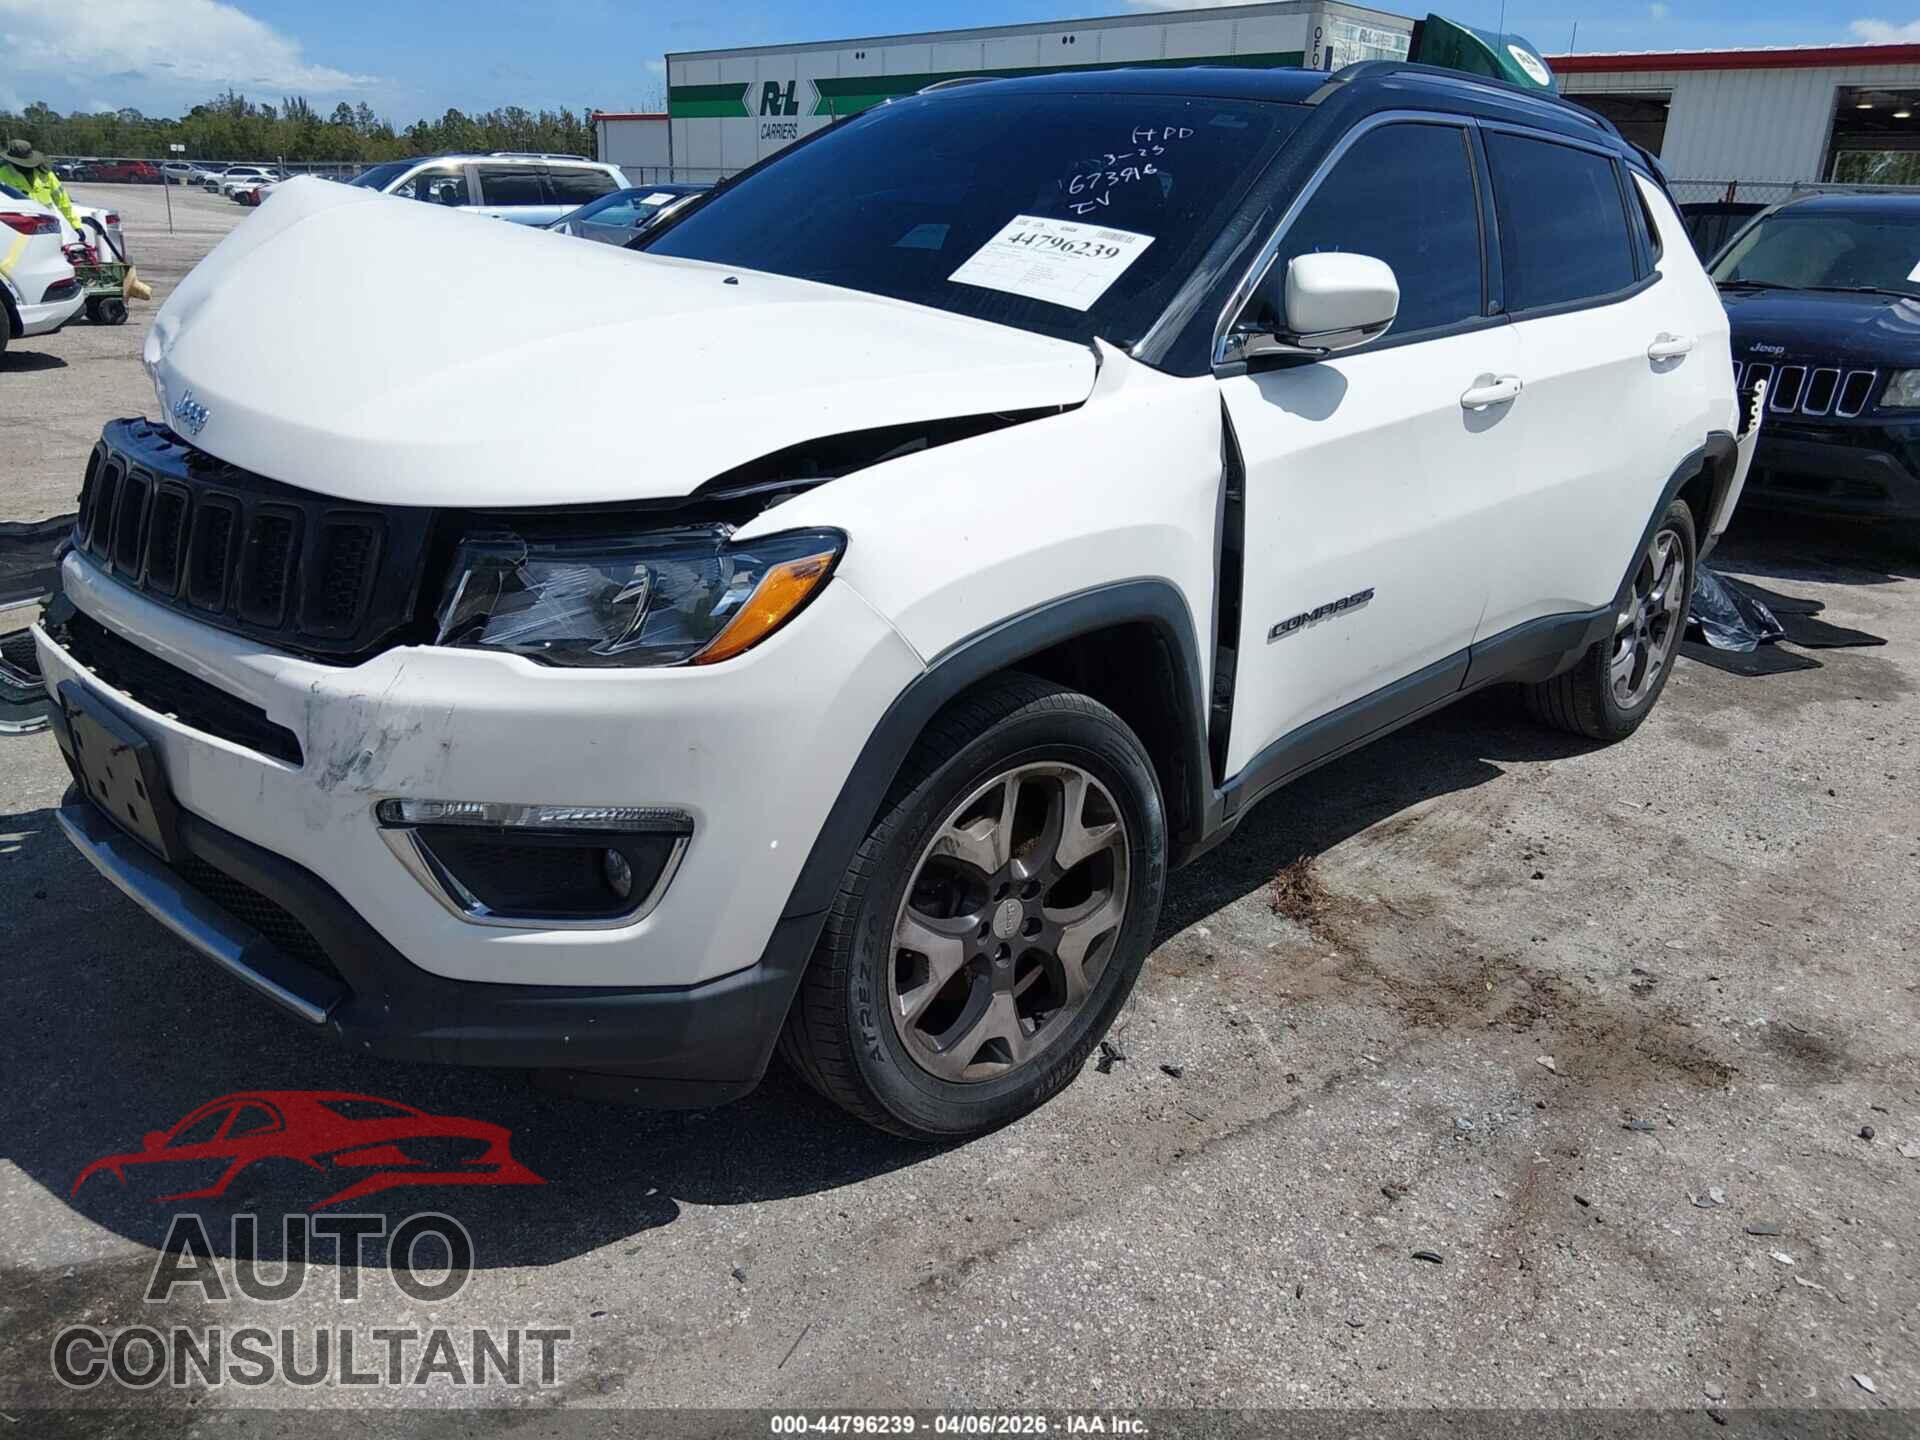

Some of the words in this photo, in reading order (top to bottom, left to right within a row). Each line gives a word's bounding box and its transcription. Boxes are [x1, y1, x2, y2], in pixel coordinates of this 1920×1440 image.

[761, 122, 798, 140] CARRIERS
[1008, 231, 1120, 260] 44796239
[1750, 342, 1784, 354] Jeep
[1268, 587, 1376, 640] COMPASS
